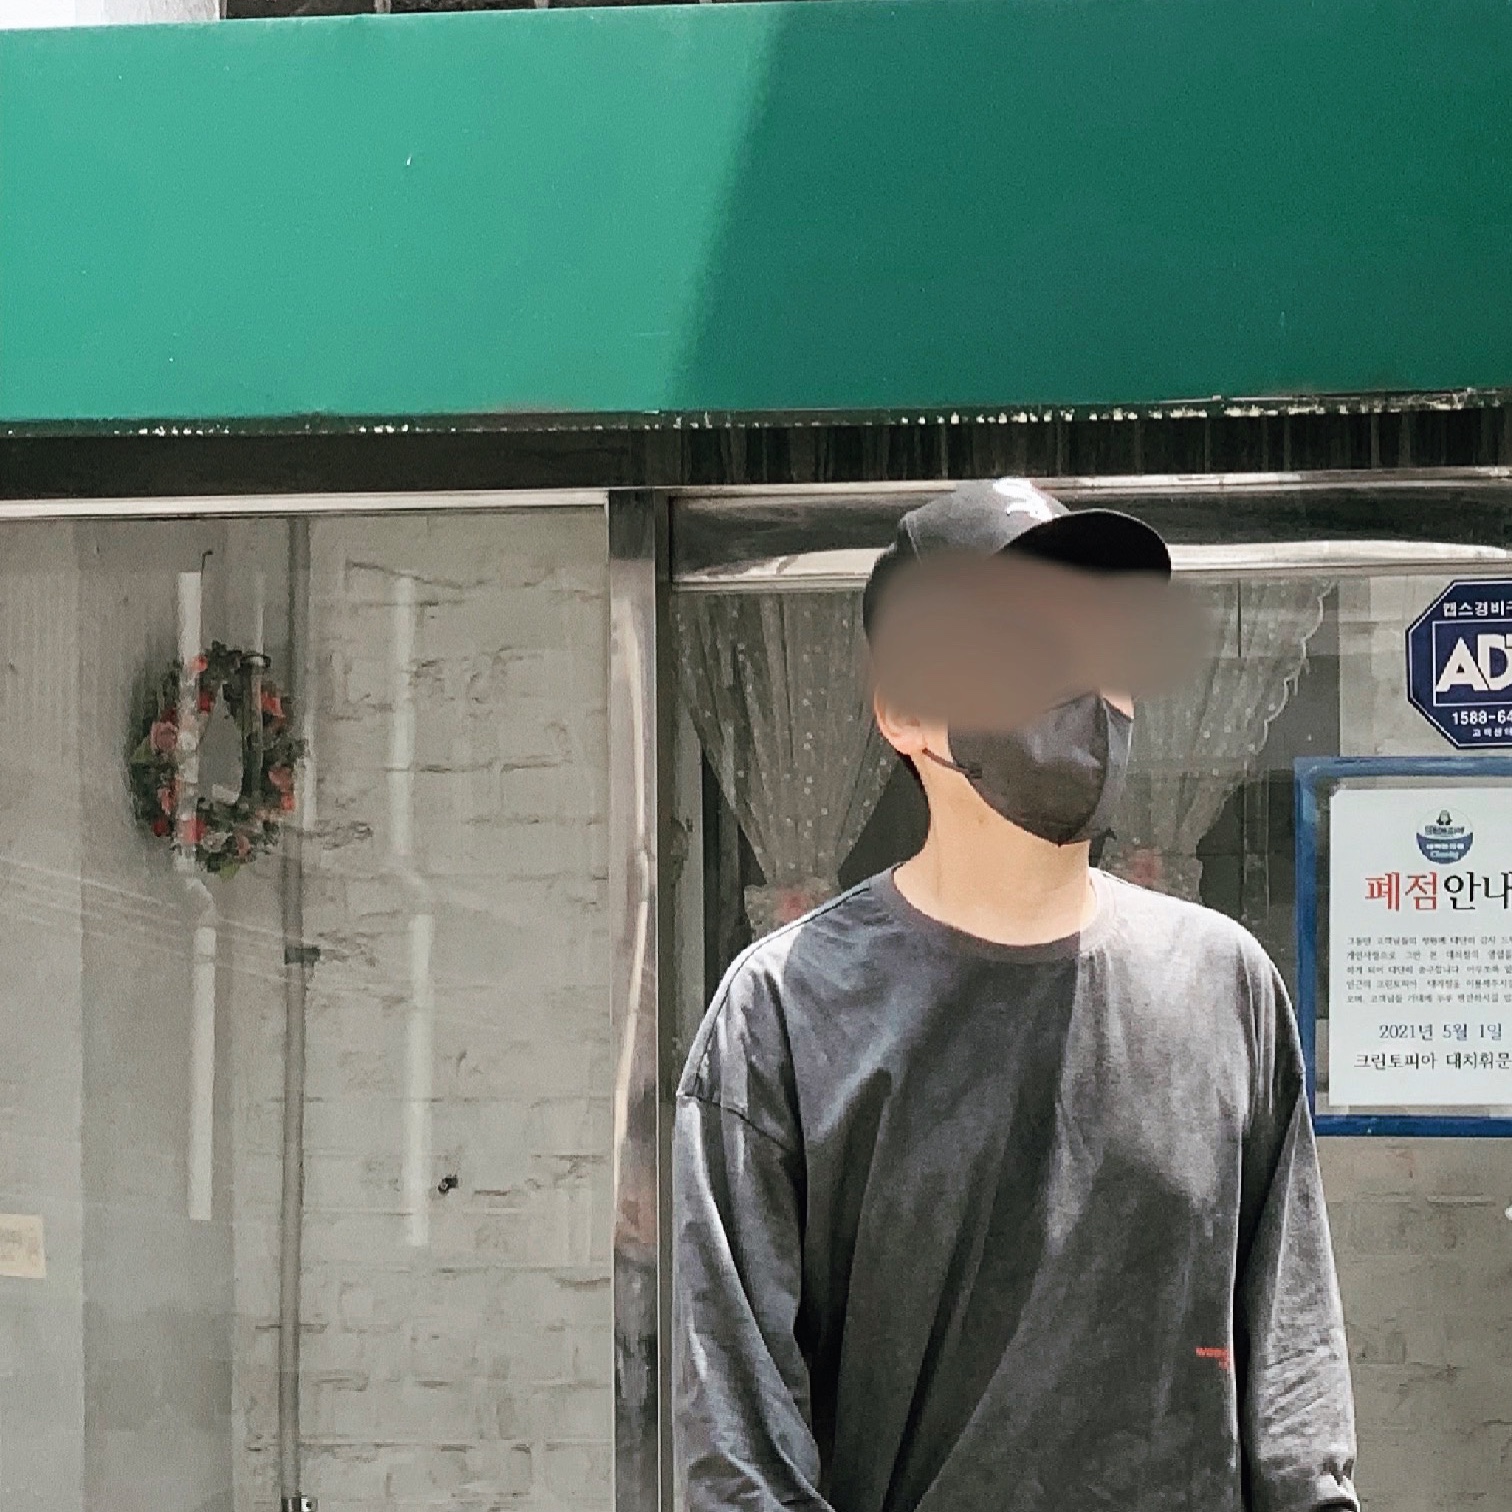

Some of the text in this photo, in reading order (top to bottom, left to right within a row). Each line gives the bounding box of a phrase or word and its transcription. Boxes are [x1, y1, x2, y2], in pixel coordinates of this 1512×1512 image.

[1379, 1022, 1503, 1041] 2021년 5월 1일
[1354, 1051, 1438, 1070] 크린토피아
